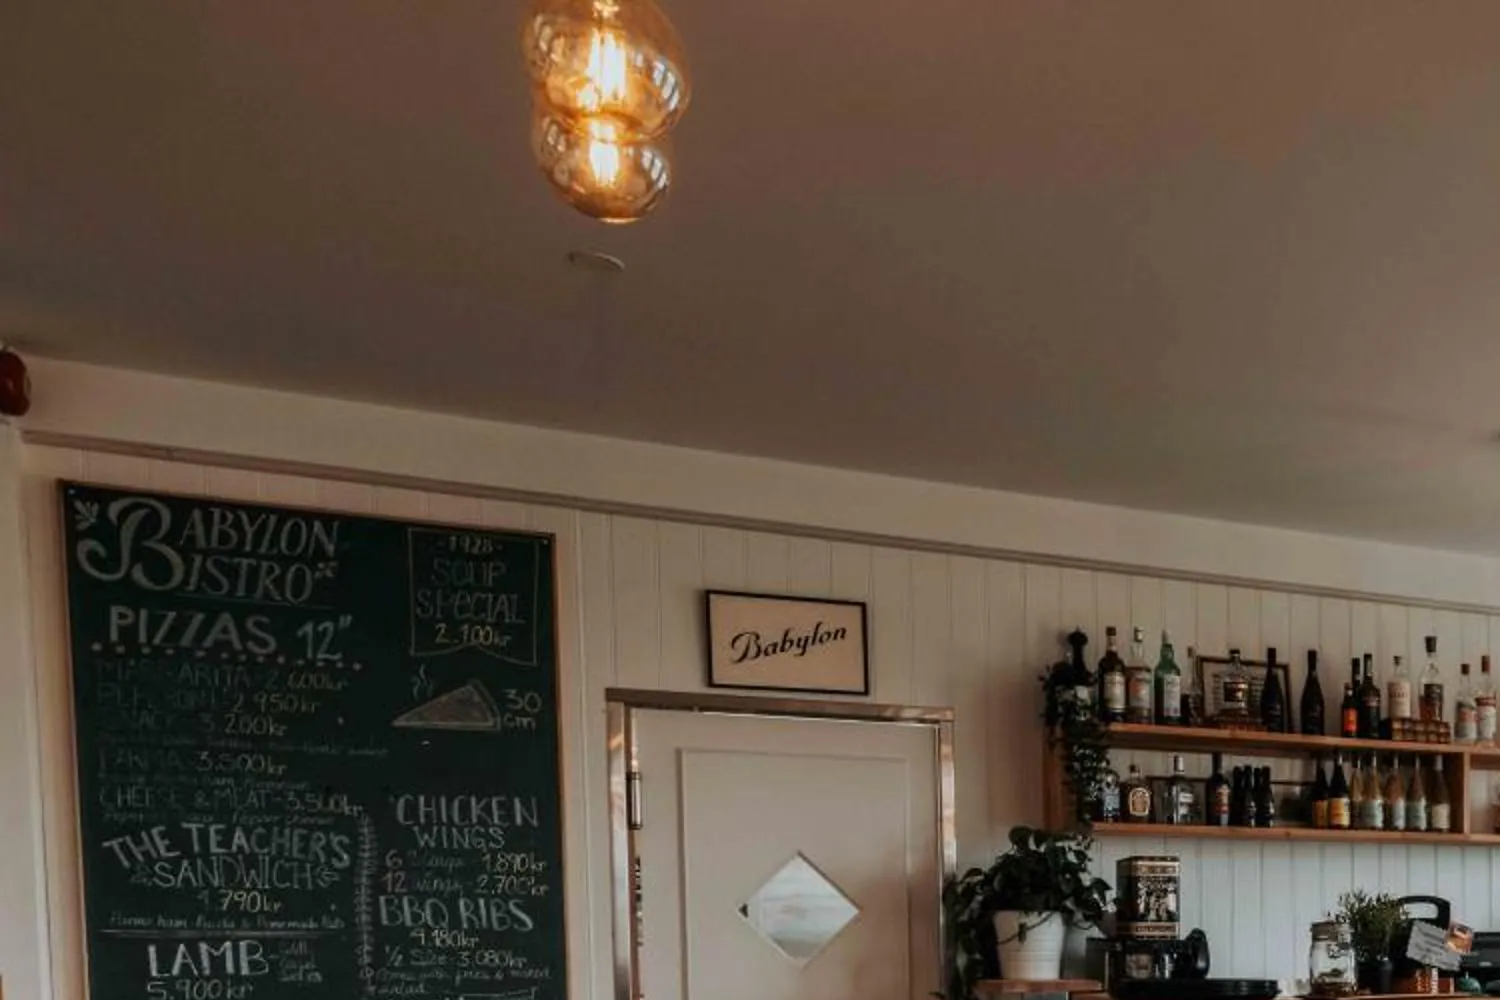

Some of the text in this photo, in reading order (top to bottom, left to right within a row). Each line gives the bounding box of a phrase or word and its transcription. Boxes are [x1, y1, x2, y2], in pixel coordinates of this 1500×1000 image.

[77, 497, 340, 580] BABYLON
[109, 605, 277, 655] PIZZAS
[730, 620, 848, 665] Babylon
[503, 688, 542, 714] 30
[503, 713, 537, 732] cm
[395, 793, 541, 828] CHICKEN
[101, 821, 351, 870] THE TEACHER'S
[412, 825, 507, 852] WINGS
[153, 853, 315, 890] SANDWICH
[385, 848, 404, 870] 6
[381, 870, 409, 894] 12
[378, 894, 450, 931] BBQ
[458, 896, 535, 934] RIBS
[147, 939, 270, 978] LAMB
